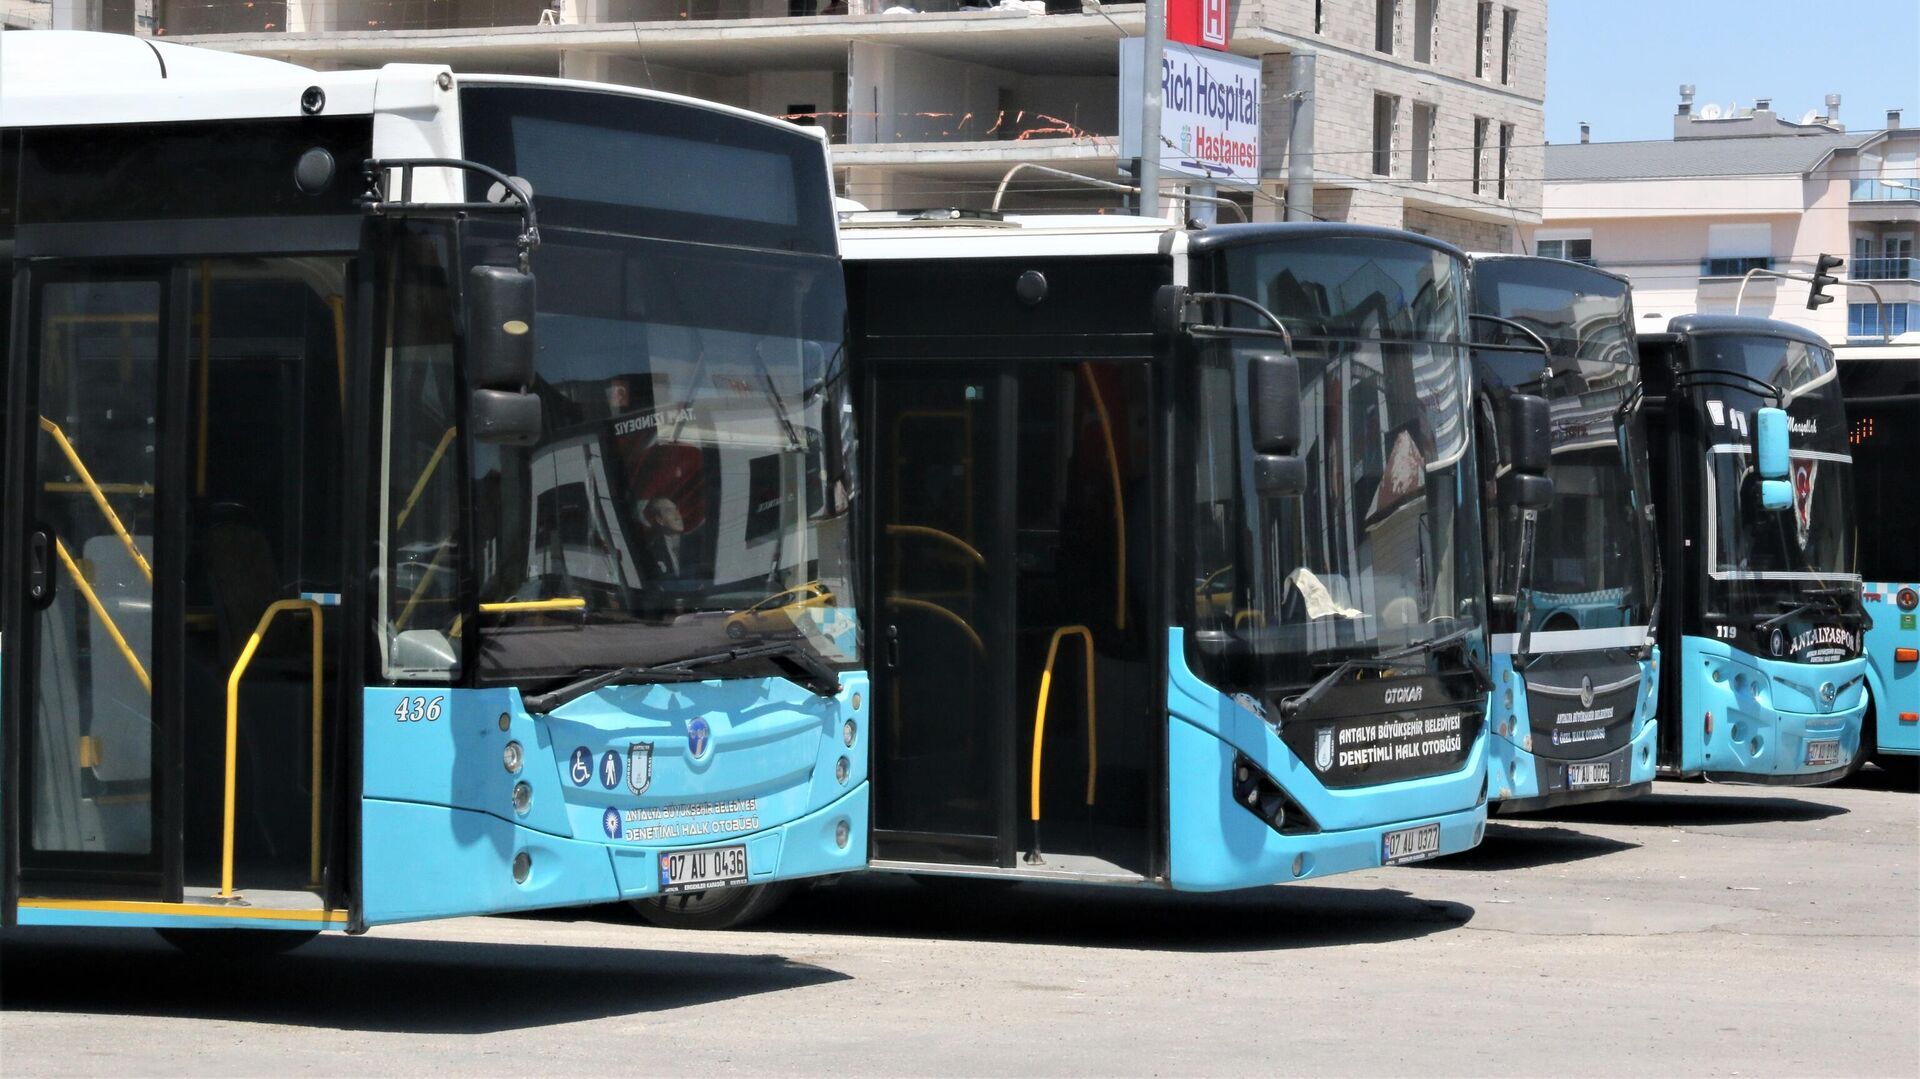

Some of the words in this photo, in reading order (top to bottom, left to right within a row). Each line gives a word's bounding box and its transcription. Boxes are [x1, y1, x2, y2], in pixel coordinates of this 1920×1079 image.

[1206, 0, 1223, 37] H
[1196, 65, 1257, 131] Hospital
[1196, 126, 1257, 169] Hastanesi
[1716, 625, 1737, 639] 119
[1789, 626, 1855, 655] ANTALYASPOR
[394, 695, 445, 723] 436
[1384, 686, 1423, 704] OTOKAR
[1338, 725, 1376, 745] ANTALYA
[1377, 718, 1423, 740] BÜYÜKŞEHİR
[1424, 713, 1461, 733] BELEDİYESİ
[1339, 743, 1393, 767] DENETİMLİ
[1395, 743, 1420, 760] HALK
[1422, 734, 1461, 755] OTOBÜSÜ
[1572, 765, 1580, 783] 07
[1582, 765, 1590, 782] AU
[625, 808, 663, 822] ANTALYA
[663, 802, 713, 819] BÜYÜKŞEHİR
[714, 796, 757, 814] BELEDİYESİ
[625, 823, 680, 842] DENETİMLİ
[681, 823, 709, 837] HALK
[711, 815, 760, 835] OTOBÜSÜ
[1389, 834, 1400, 855] 07
[1403, 832, 1414, 854] AU
[1417, 827, 1438, 851] 0377
[669, 855, 685, 880] 07
[691, 853, 706, 879] AU
[714, 850, 744, 877] 0436
